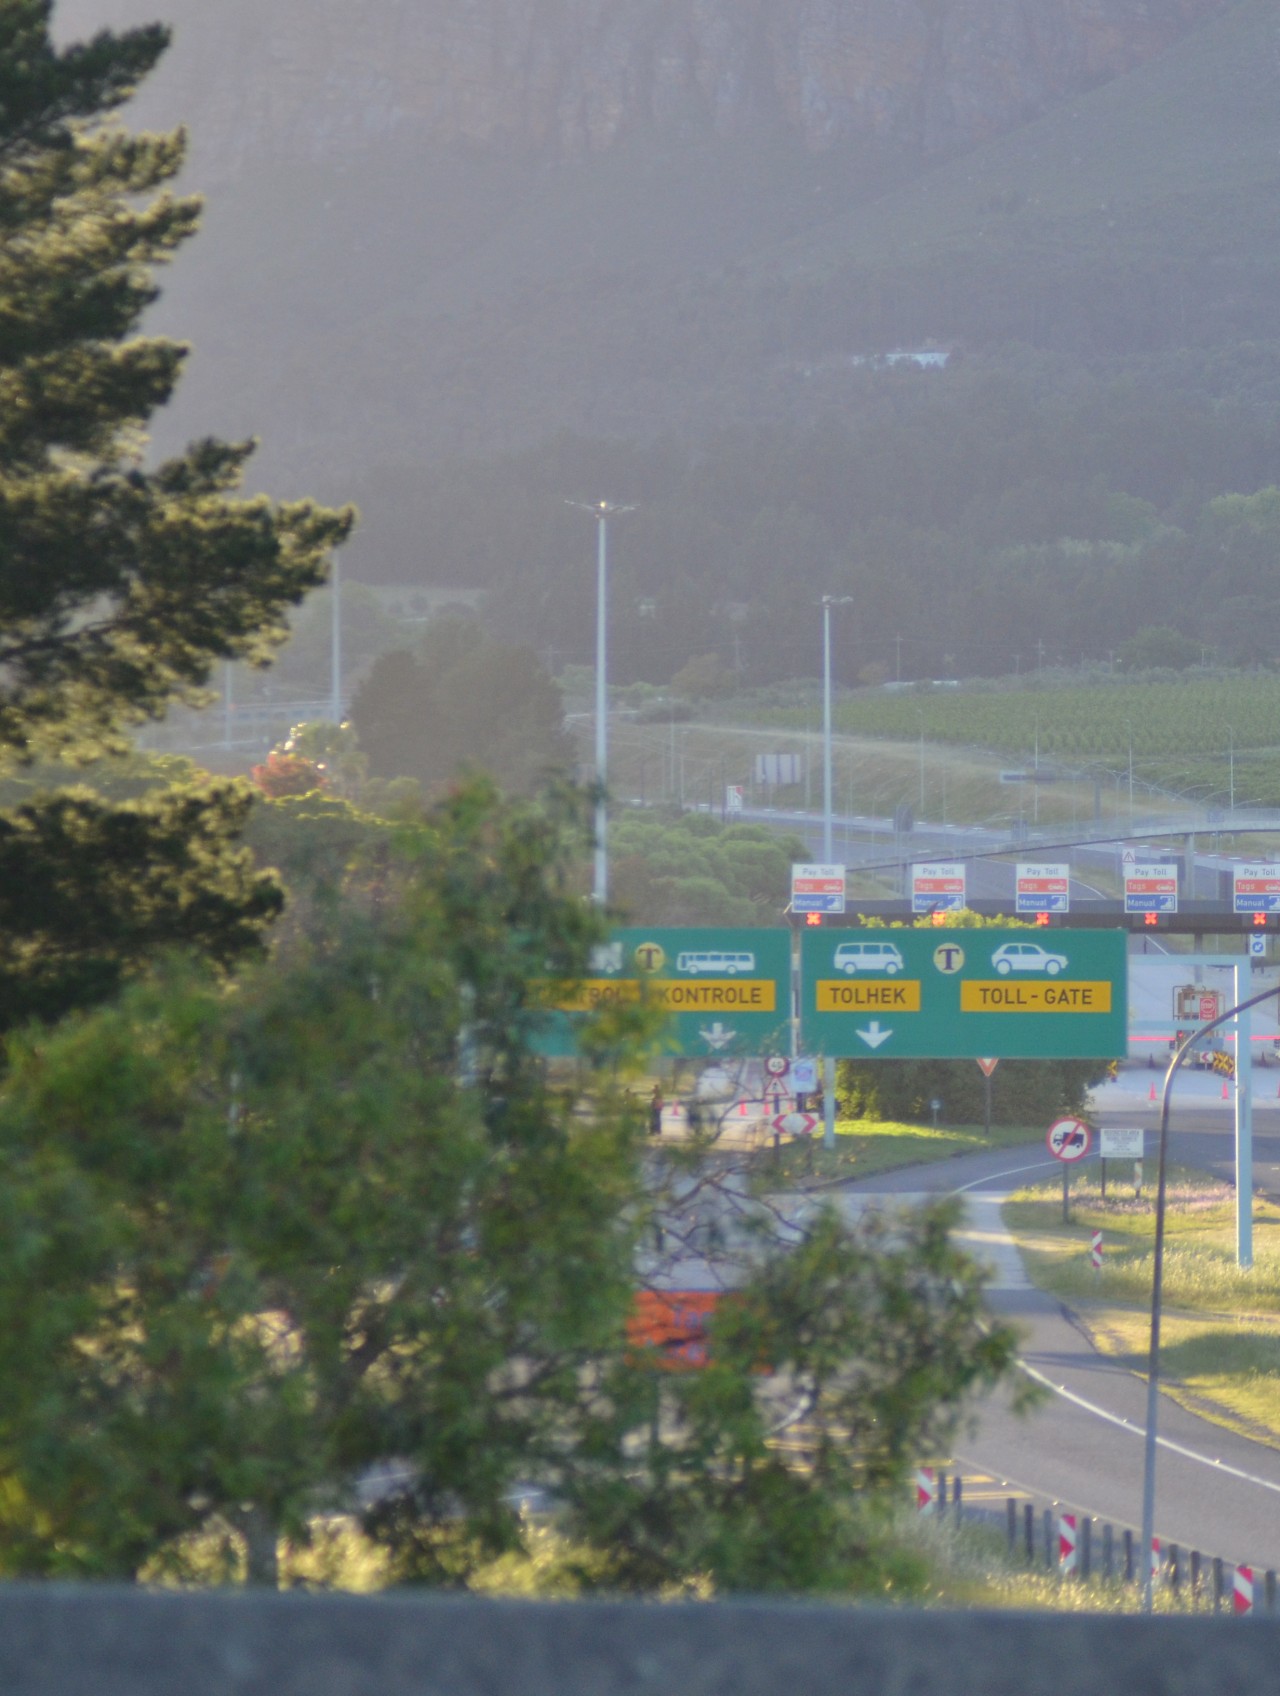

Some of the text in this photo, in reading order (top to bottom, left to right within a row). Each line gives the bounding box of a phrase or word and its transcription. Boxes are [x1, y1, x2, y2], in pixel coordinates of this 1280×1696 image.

[802, 867, 834, 877] Pay Toll
[922, 867, 954, 877] Pay Toll
[1026, 867, 1058, 877] Pay Toll
[1135, 868, 1167, 877] Pay Toll
[1244, 868, 1276, 877] Pay Toll
[1019, 881, 1037, 891] Tags
[1127, 881, 1145, 891] Tags
[1236, 881, 1255, 892] Tags
[795, 899, 823, 907] Manual
[1019, 899, 1047, 907] Manual
[1127, 899, 1156, 907] Manual
[1236, 899, 1265, 907] Manual
[938, 948, 960, 970] T
[659, 987, 762, 1004] KONTROLE
[829, 987, 906, 1004] TOLHEK
